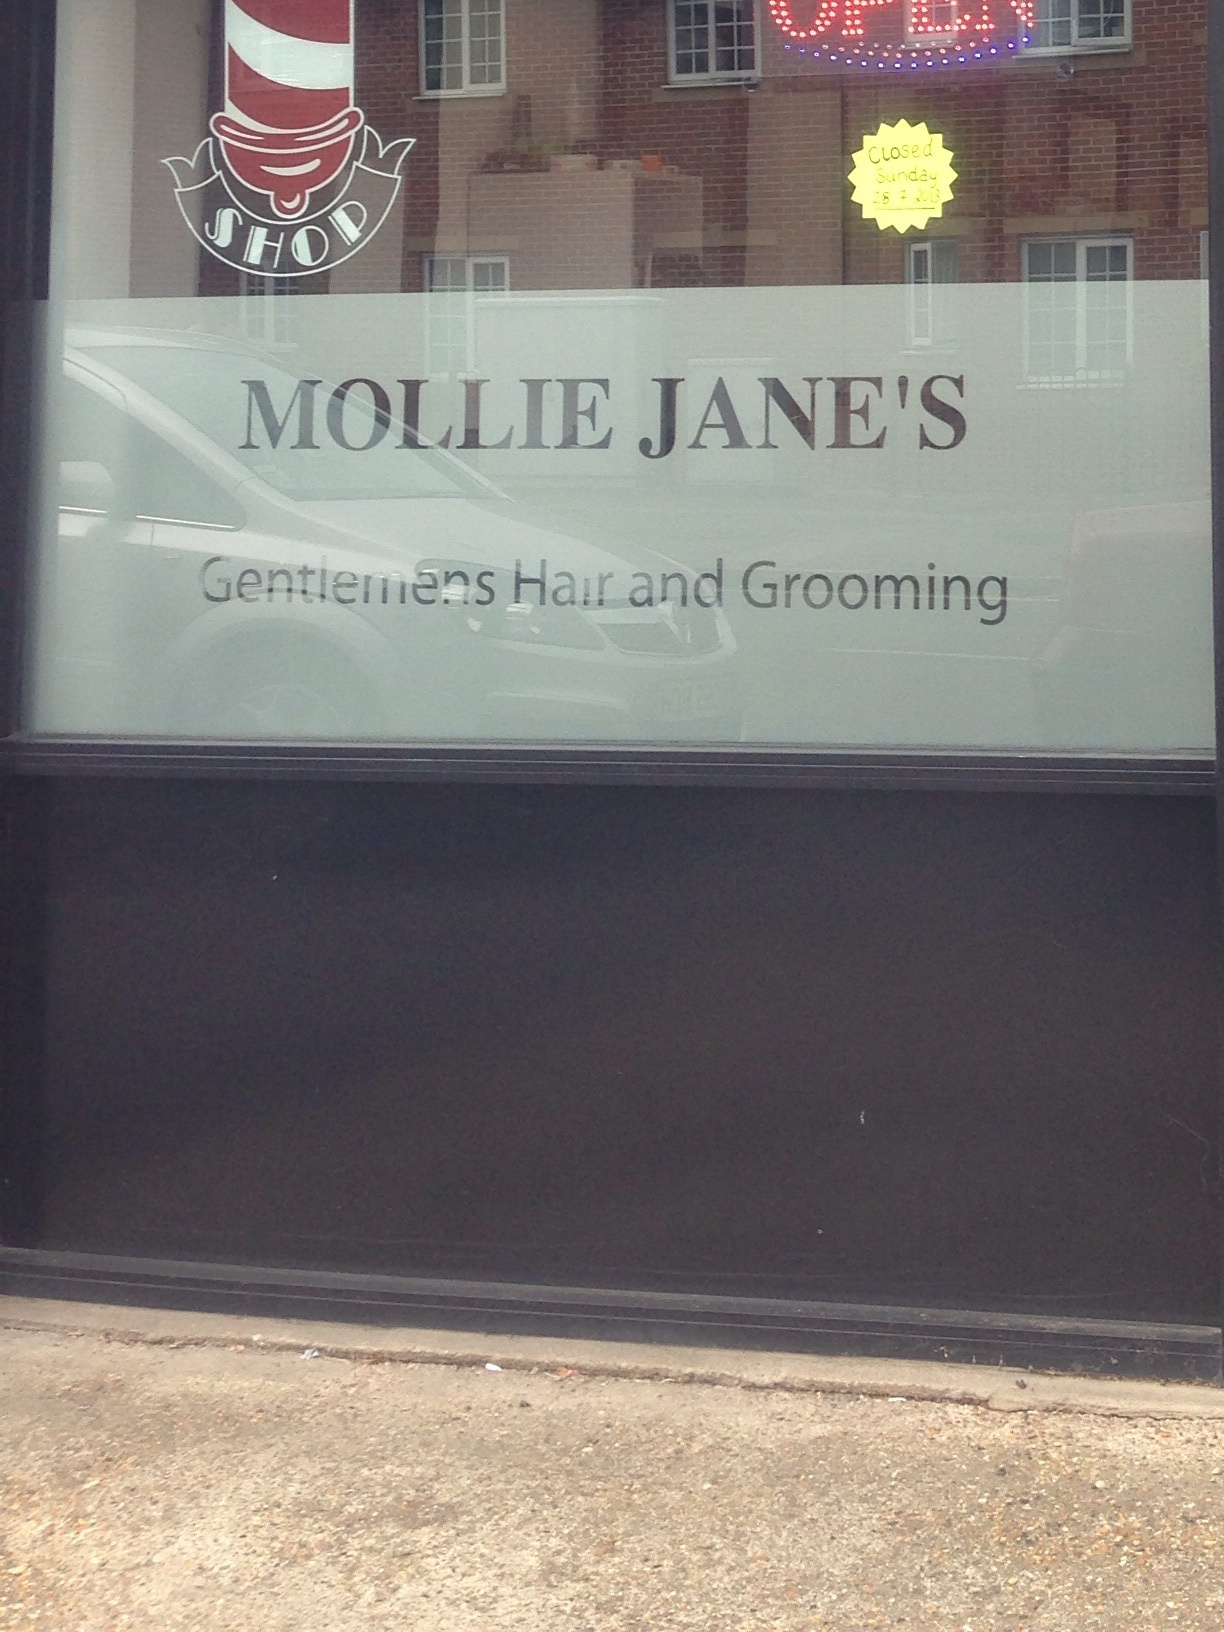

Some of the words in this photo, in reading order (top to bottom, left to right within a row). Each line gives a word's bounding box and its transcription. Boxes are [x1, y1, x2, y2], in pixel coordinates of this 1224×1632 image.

[868, 137, 933, 164] Closed
[876, 166, 937, 188] Sunday
[204, 200, 367, 268] SHOP
[238, 377, 614, 453] MOLLIE
[638, 373, 968, 459] JANE'S
[202, 555, 496, 607] Gentlemens
[514, 558, 614, 608] Hair
[629, 557, 724, 610] and
[741, 560, 1010, 625] Grooming
